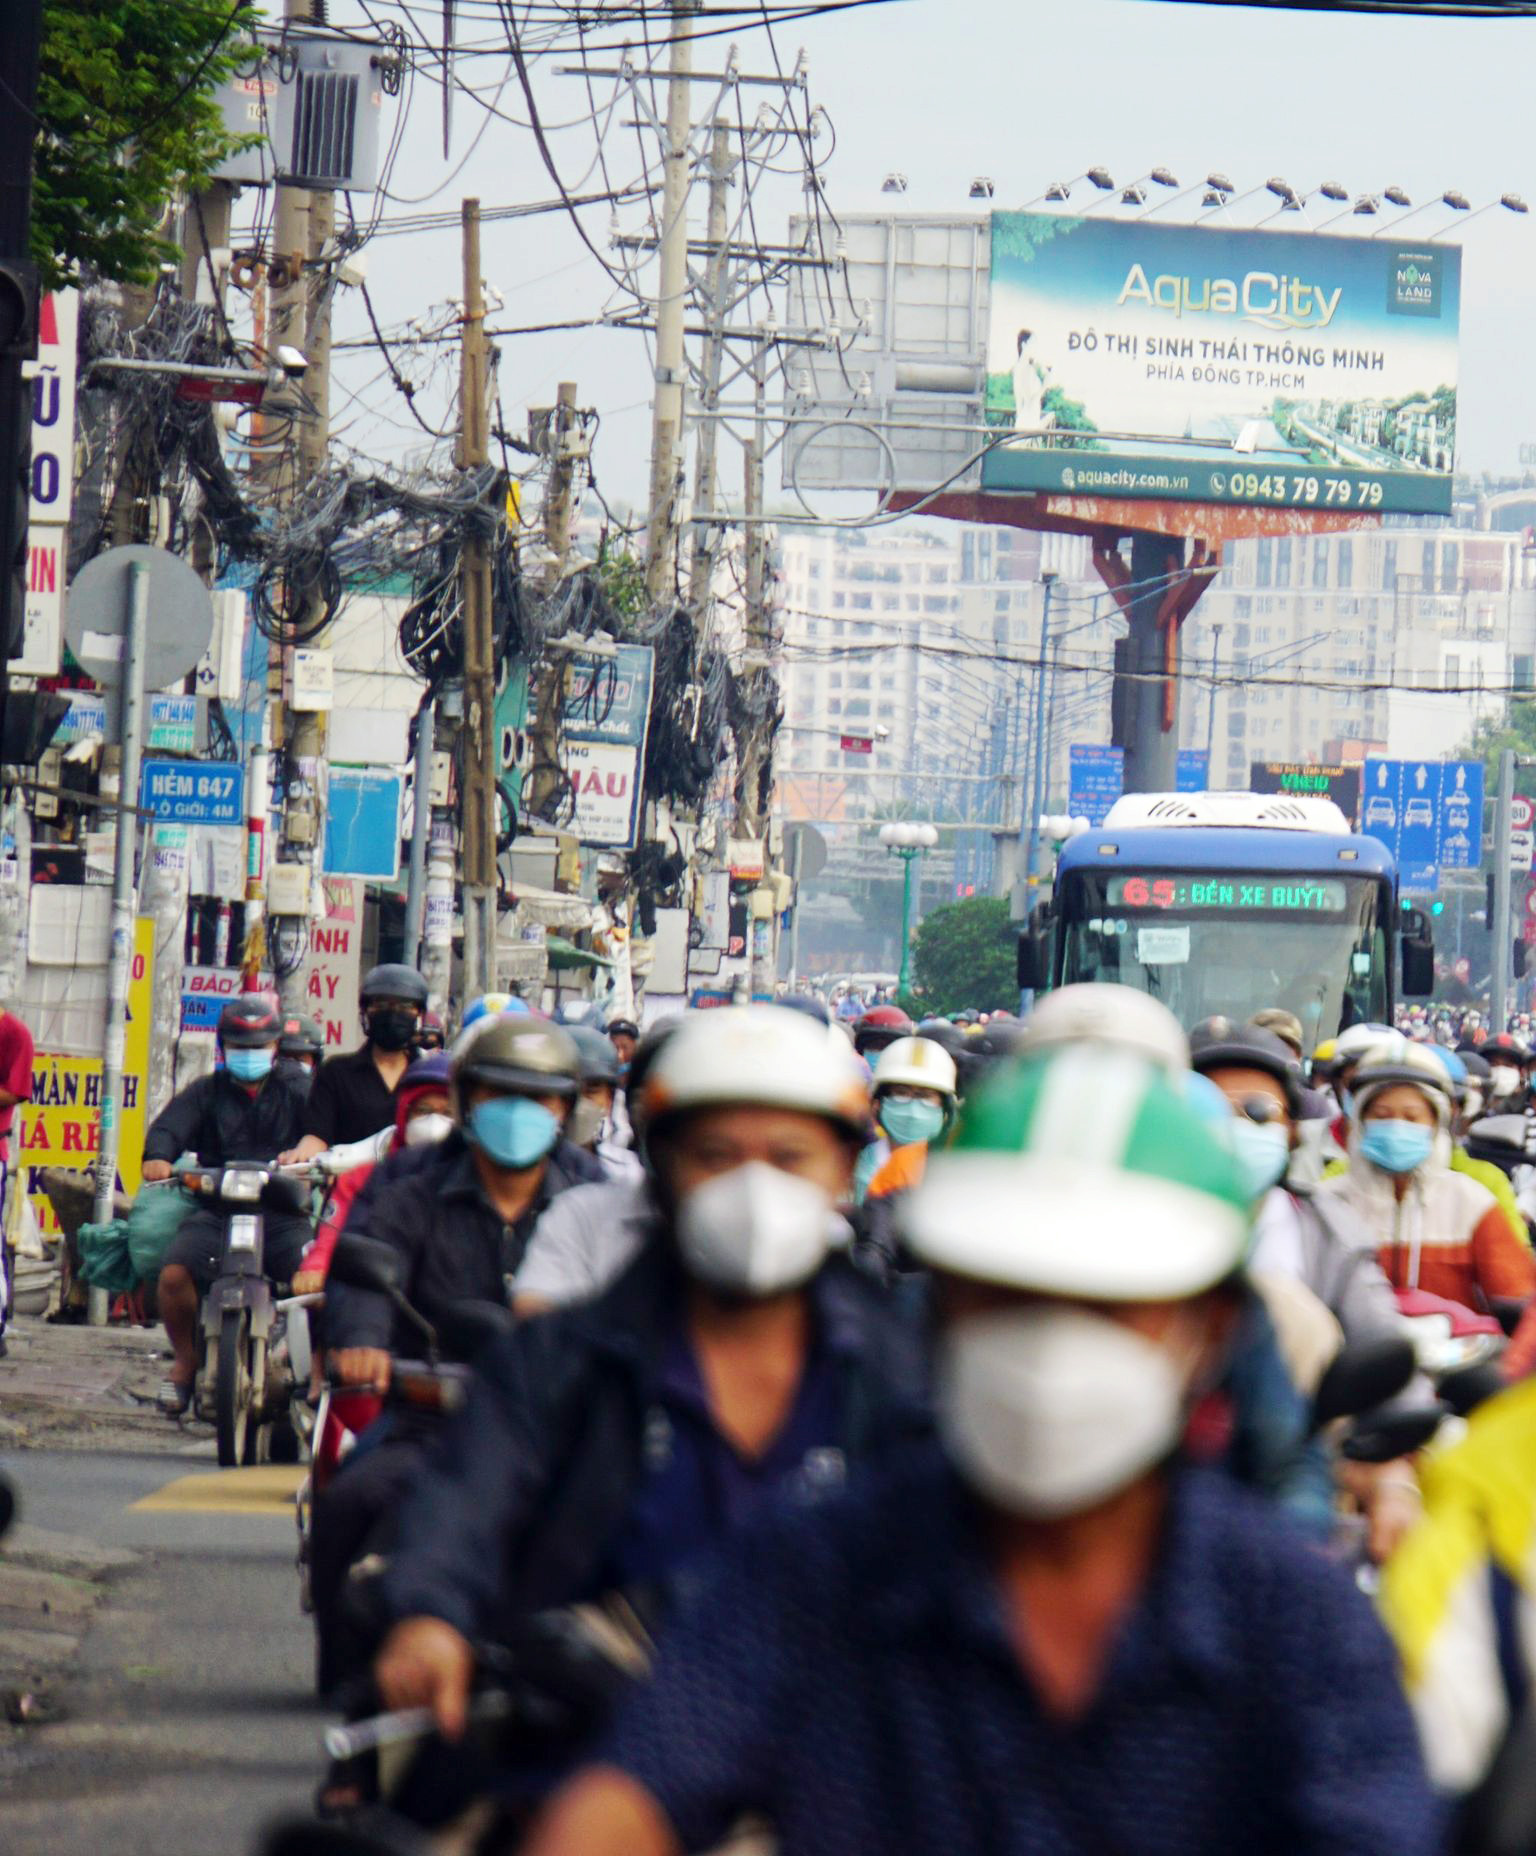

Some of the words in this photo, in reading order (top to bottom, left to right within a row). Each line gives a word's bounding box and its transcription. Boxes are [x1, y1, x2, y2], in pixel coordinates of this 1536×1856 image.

[1397, 286, 1432, 298] LAND
[1068, 327, 1097, 351] ĐÔ
[1104, 334, 1138, 359] THỊ
[1145, 336, 1193, 359] SINH
[1200, 336, 1248, 363] THÁI
[1253, 340, 1325, 367] THÔNG
[1332, 347, 1385, 371] MINH
[1146, 361, 1184, 381] PHÍA
[1191, 364, 1240, 385] ĐÔNG
[1247, 371, 1305, 389] TP.HCM
[1077, 468, 1189, 490] aquacity.com.vn
[1230, 473, 1286, 499] 0943
[1291, 476, 1319, 502] 79
[1324, 479, 1351, 504] 79
[1358, 481, 1383, 506] 79
[152, 769, 193, 796] HẺM
[198, 776, 234, 799] 647
[212, 804, 234, 818] 4M
[1122, 876, 1176, 908] 65
[1191, 880, 1233, 905] BẾN
[1239, 885, 1266, 906] XE
[1271, 880, 1326, 909] BUÝT
[189, 973, 234, 994] BẢO
[30, 1062, 79, 1106] MÀN
[85, 1073, 138, 1108] HH
